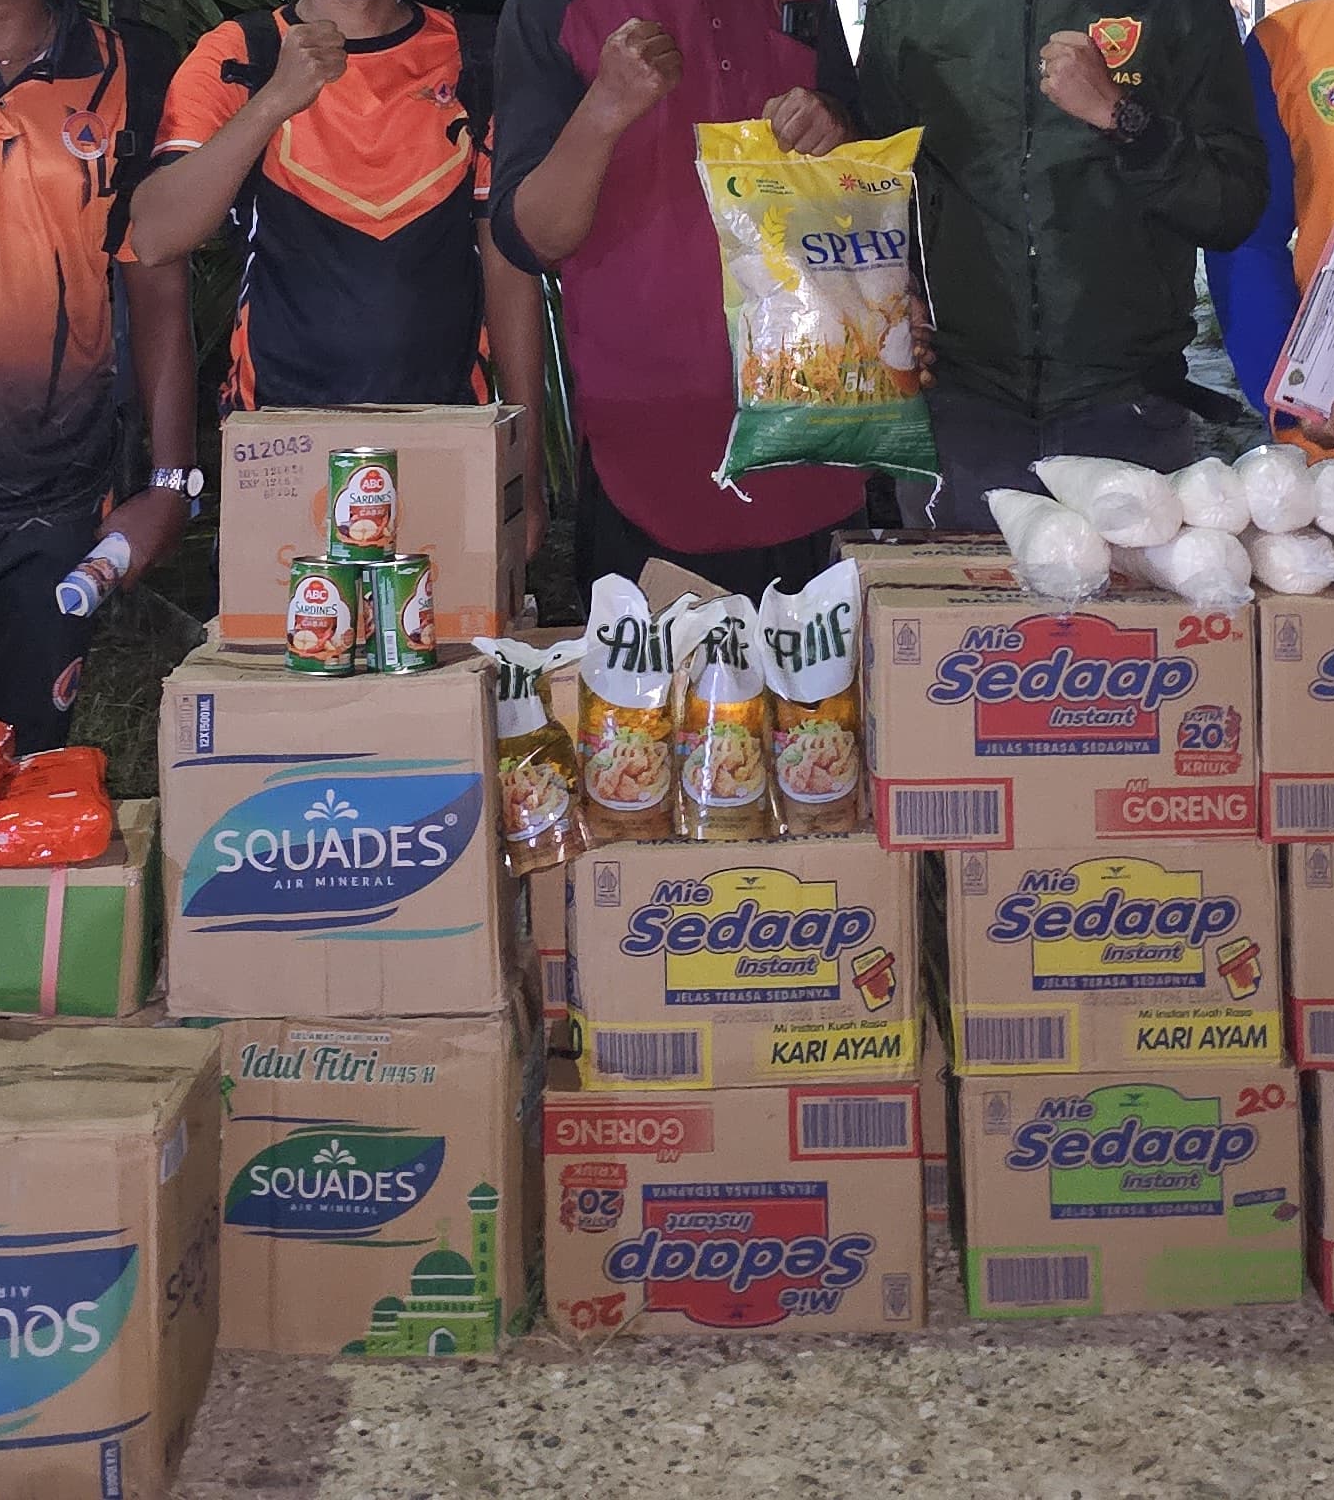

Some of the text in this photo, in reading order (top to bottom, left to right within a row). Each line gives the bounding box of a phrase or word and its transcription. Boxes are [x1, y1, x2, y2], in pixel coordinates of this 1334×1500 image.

[802, 229, 906, 265] SPHP
[234, 435, 313, 462] 612043
[361, 479, 383, 489] ABC
[350, 491, 392, 504] SARDINES
[305, 589, 327, 600] ABC
[295, 601, 338, 615] SARDINES
[963, 626, 1024, 652] Mie
[928, 649, 1197, 710] Sedaap
[1049, 706, 1137, 727] Instant
[1123, 793, 1248, 823] GORENG
[214, 825, 448, 873] SQUADES
[274, 876, 395, 890] AIR MINERAL
[653, 880, 713, 905] Mie
[1021, 872, 1078, 894] Mie
[988, 887, 1240, 947] Sedaap
[621, 900, 875, 961] Sedaap
[735, 957, 818, 976] Instant
[1102, 944, 1184, 963] Instant
[675, 988, 830, 1004] JELAS TERASA SEDAPNYA
[771, 1034, 901, 1064] KARI AYAM
[1138, 1024, 1267, 1050] KARI AYAM
[241, 1043, 436, 1083] Idul Fitri 1445 H
[1036, 1097, 1096, 1121] Mie
[556, 1117, 684, 1146] GORENG
[1005, 1116, 1259, 1175] Sedaap
[250, 1165, 417, 1202] SQUADES
[1120, 1171, 1202, 1191] Instant
[665, 1211, 754, 1233] Instant
[605, 1228, 875, 1291] Sedaap
[780, 1288, 844, 1315] Mie
